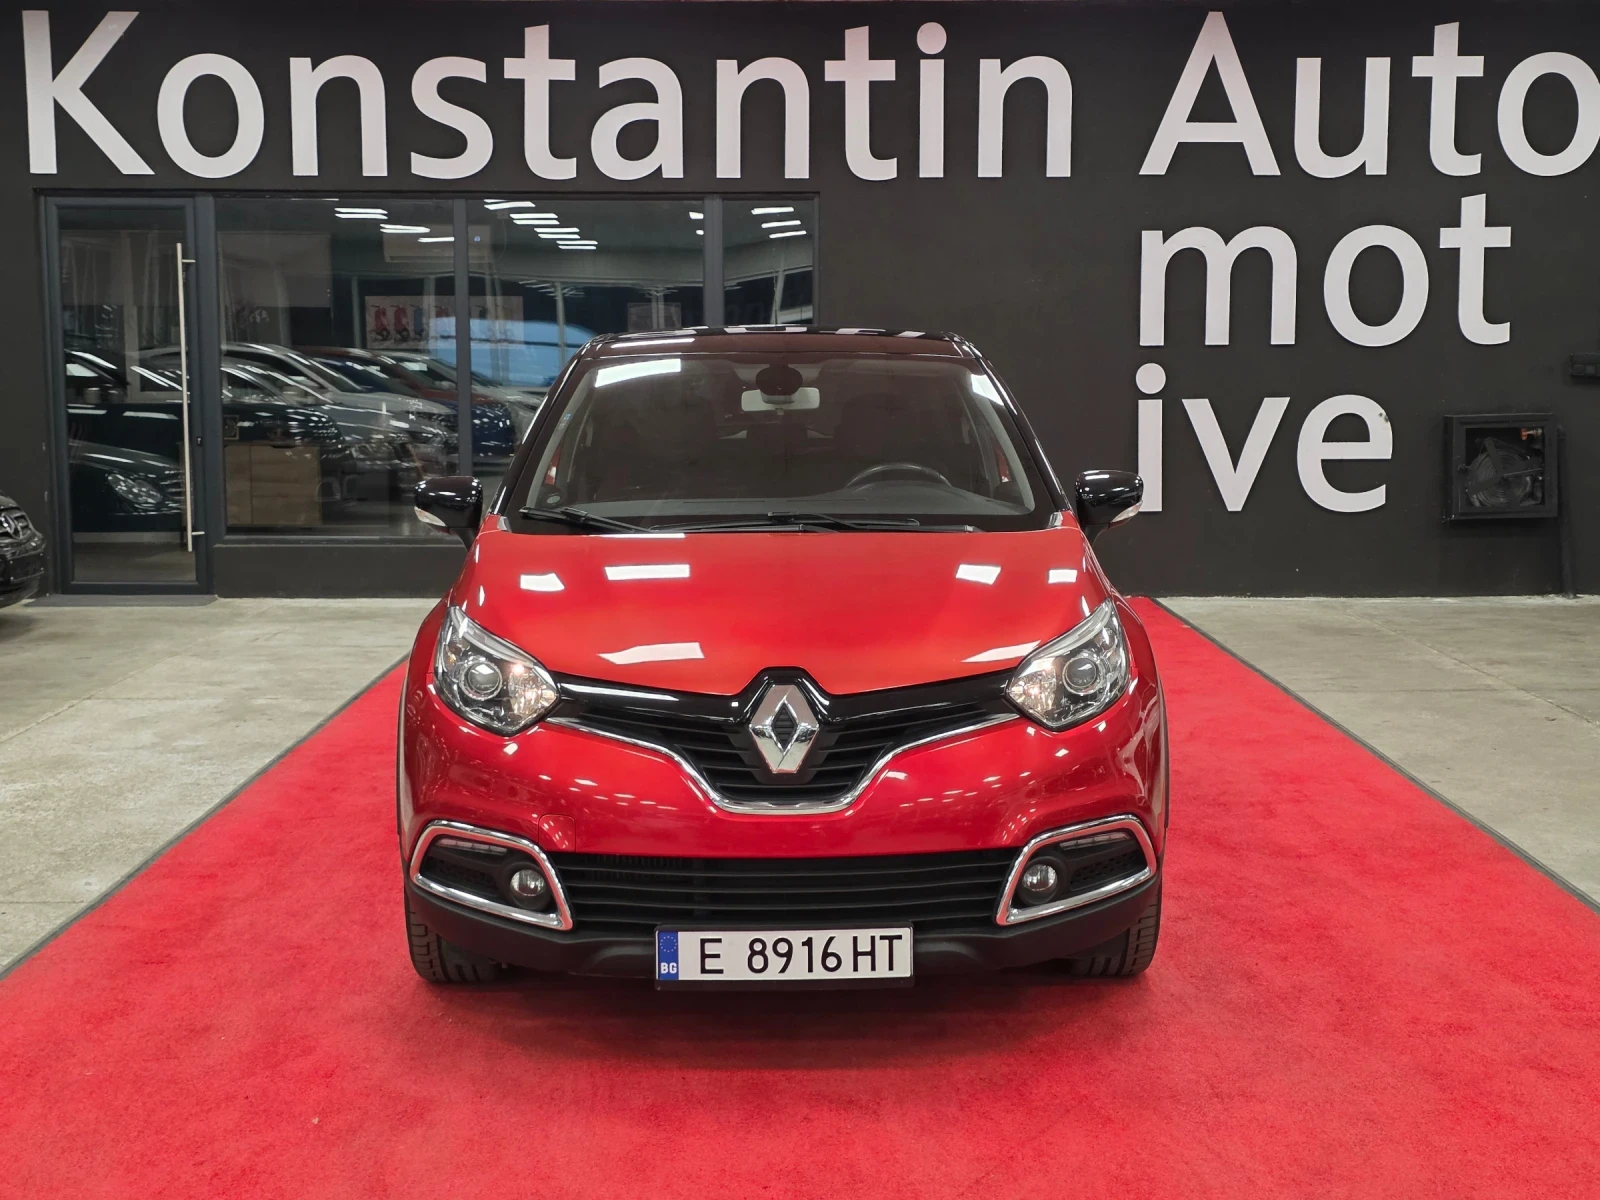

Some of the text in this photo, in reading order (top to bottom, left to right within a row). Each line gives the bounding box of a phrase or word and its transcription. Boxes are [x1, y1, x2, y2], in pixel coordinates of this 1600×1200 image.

[22, 10, 1600, 182] Konstantin Auto
[1138, 192, 1513, 347] mot
[1135, 362, 1394, 513] ive
[660, 962, 677, 974] BG
[699, 937, 724, 975] E
